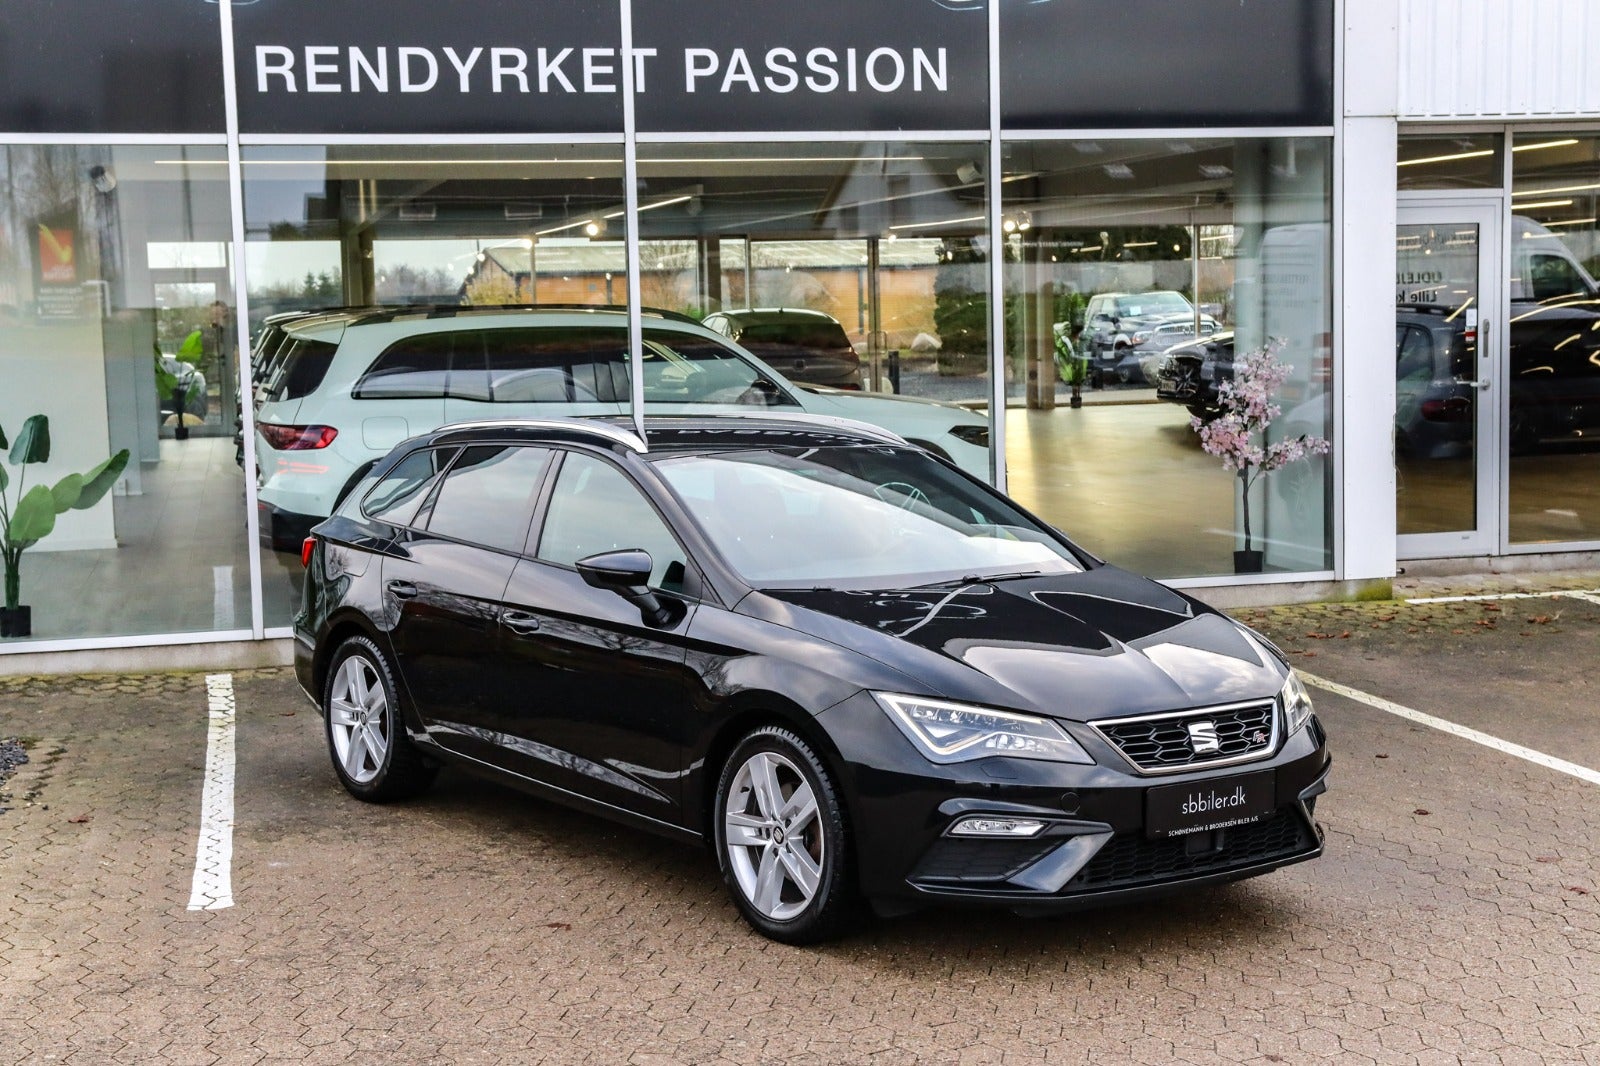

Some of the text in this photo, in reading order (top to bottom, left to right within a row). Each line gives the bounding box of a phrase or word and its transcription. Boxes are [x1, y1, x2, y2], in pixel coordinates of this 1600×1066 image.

[255, 45, 948, 92] RENDYRKET PASSION
[1181, 785, 1246, 815] sbbiler.dk
[1237, 817, 1250, 826] BILER
[1250, 815, 1259, 823] A/S
